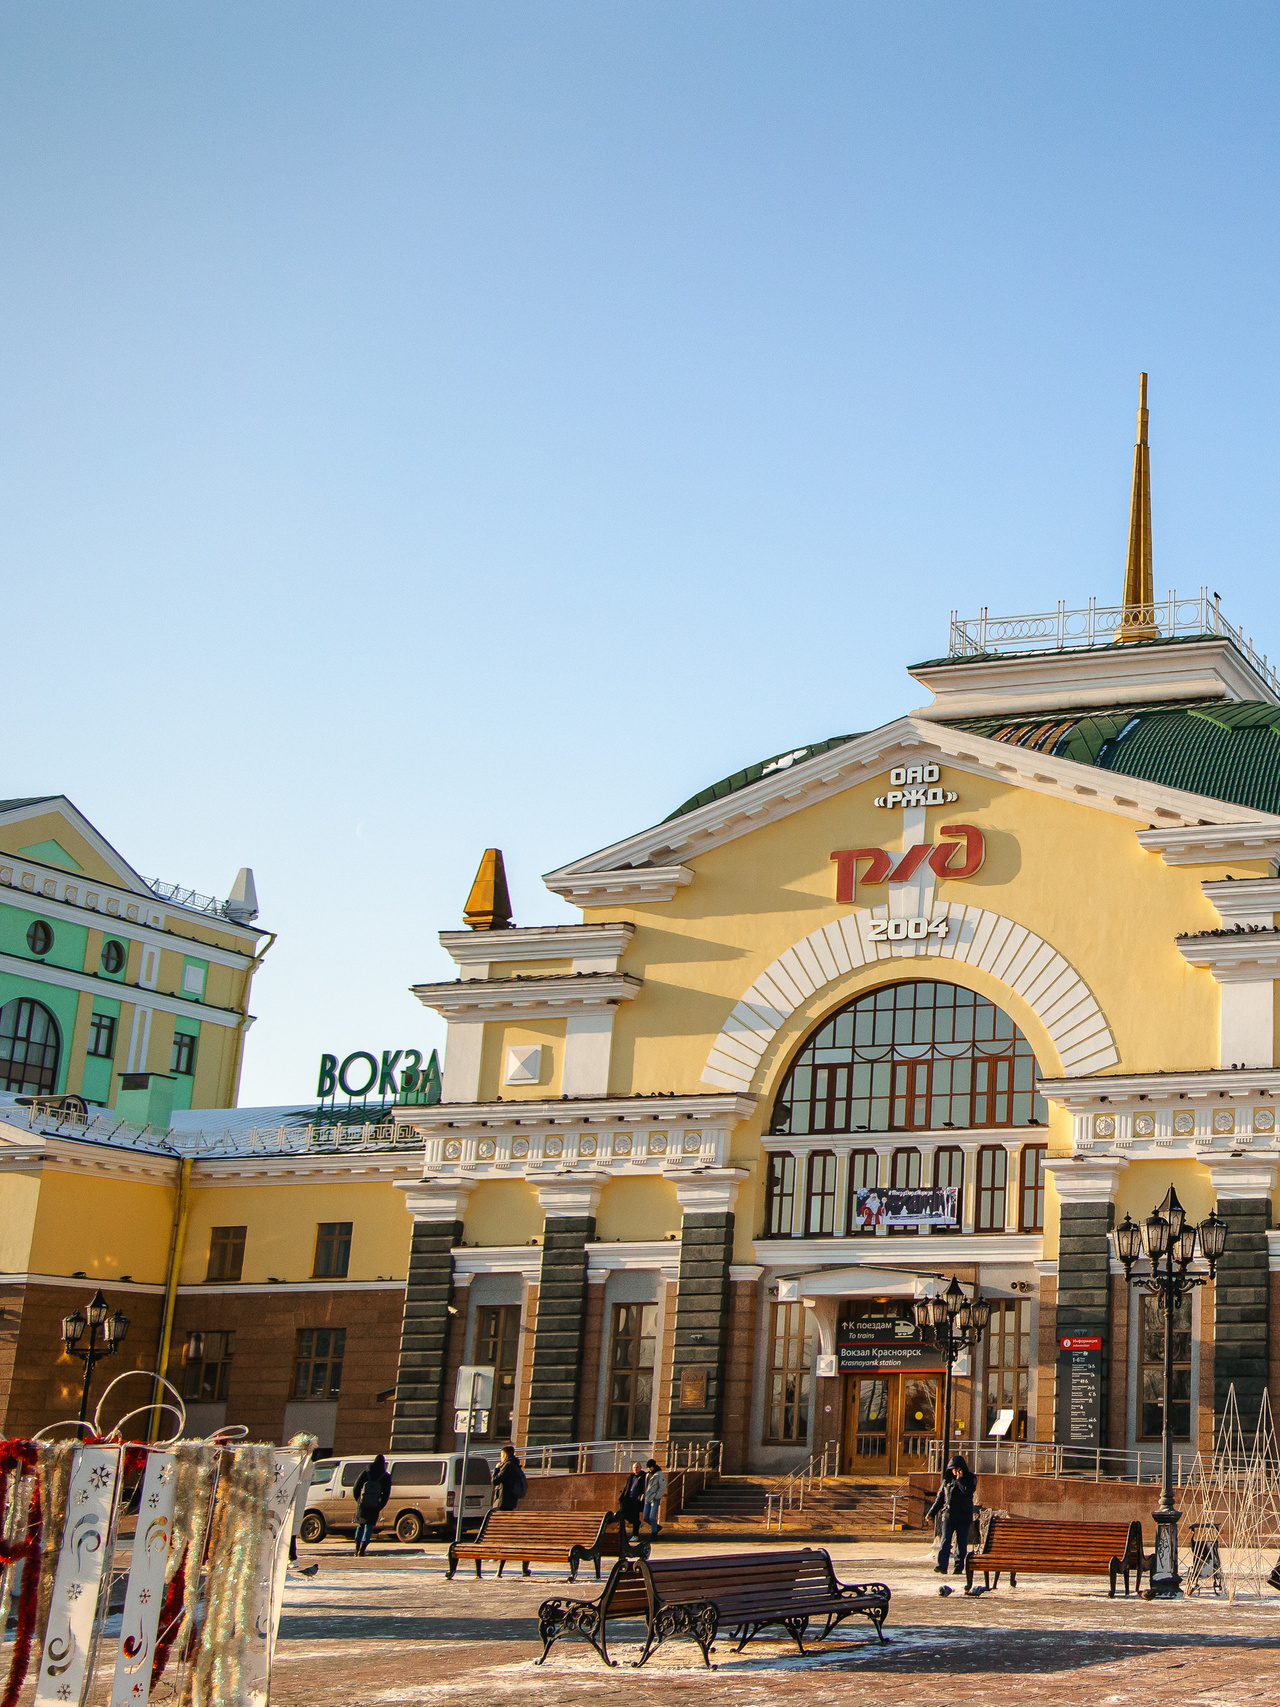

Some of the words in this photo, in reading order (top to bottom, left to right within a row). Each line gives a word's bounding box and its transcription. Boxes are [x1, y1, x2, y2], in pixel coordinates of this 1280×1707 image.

[890, 764, 940, 786] ОАО
[867, 915, 949, 941] 2004
[316, 1048, 442, 1098] ВОКЗА
[848, 1321, 855, 1330] К
[856, 1322, 892, 1331] поездам
[841, 1348, 870, 1357] Вокзал
[872, 1347, 922, 1358] Красноярск
[840, 1359, 878, 1367] Krasnoyarsk
